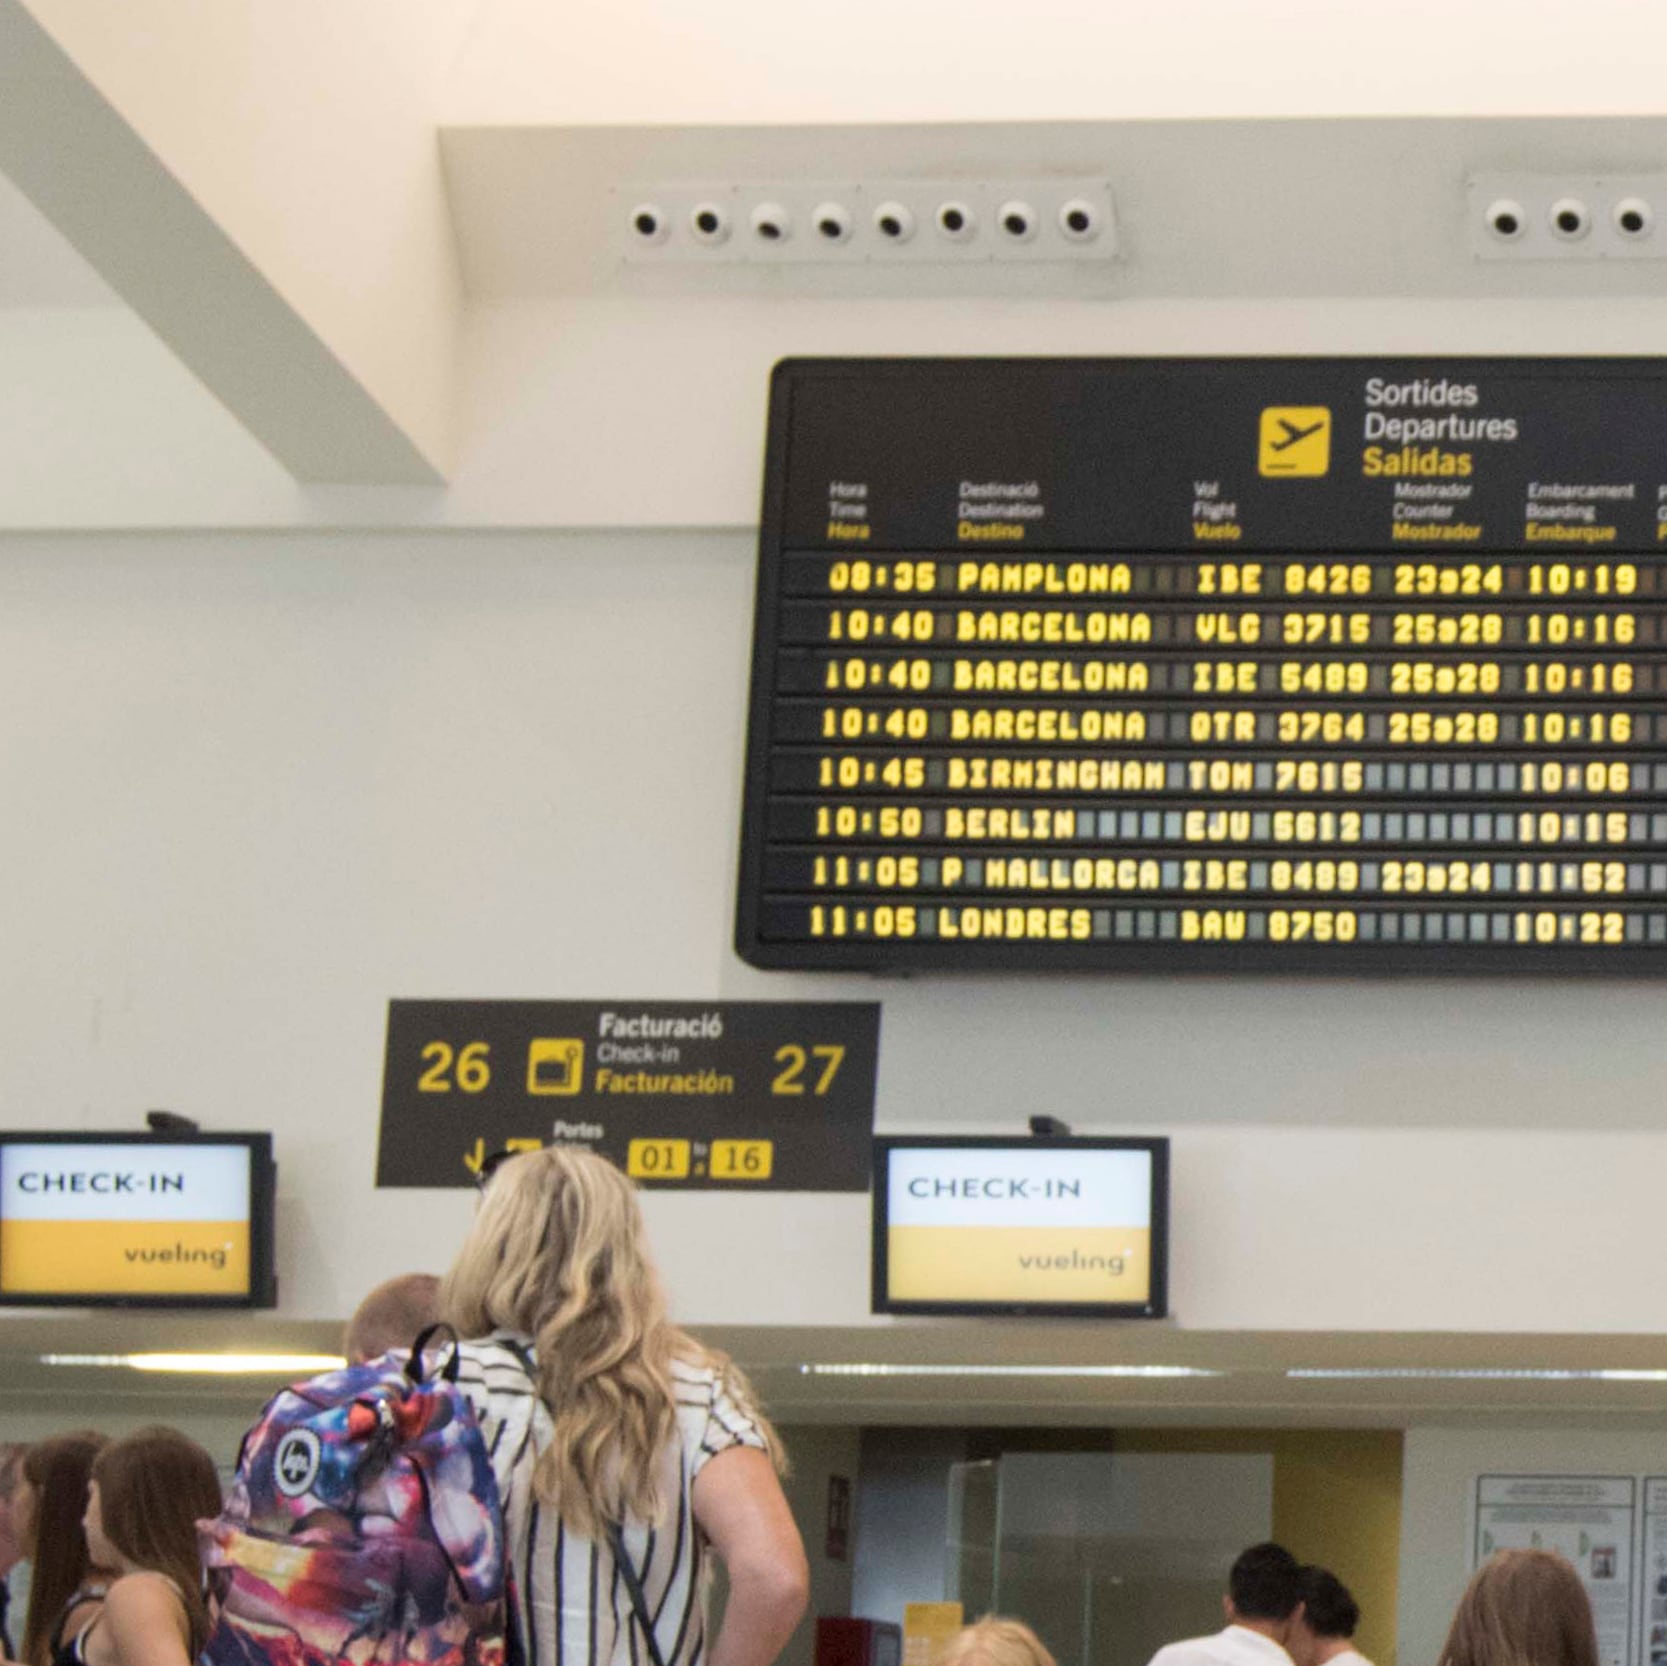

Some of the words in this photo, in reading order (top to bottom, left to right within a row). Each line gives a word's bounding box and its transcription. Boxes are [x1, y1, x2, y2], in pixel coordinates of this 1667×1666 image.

[1365, 377, 1478, 407] Sortides
[1364, 412, 1518, 446] Departures
[1363, 446, 1473, 476] Salidas
[830, 562, 935, 591] 08:35
[959, 563, 1130, 593] PAMPLONA
[1198, 564, 1261, 593] IBE
[1285, 565, 1371, 594] 8426
[1530, 565, 1636, 594] 10:19
[830, 610, 933, 640] 10:40
[957, 611, 1150, 642] BARCELONA
[1196, 614, 1260, 643] VLG
[1284, 614, 1370, 643] 3715
[1529, 614, 1634, 643] 10:16
[824, 708, 927, 738] 10:40
[952, 710, 1145, 740] BARCELONA
[1280, 712, 1364, 742] 3764
[1525, 713, 1630, 742] 10:16
[821, 757, 924, 787] 10:45
[949, 759, 1164, 790] BIRMINGHAM
[1278, 762, 1362, 791] 7615
[1524, 763, 1629, 792] 10:06
[818, 807, 921, 837] 10:50
[946, 808, 1074, 838] BERLIN
[815, 857, 918, 886] 11:05
[942, 858, 962, 886] P
[986, 859, 1159, 889] MALLORCA
[1186, 861, 1247, 890] IBE
[1515, 862, 1625, 892] 11:52
[812, 907, 915, 936] 11:05
[939, 908, 1090, 939] LONDRES
[1183, 911, 1245, 940] BAW
[1270, 911, 1356, 941] 8750
[1519, 912, 1623, 942] 10:22
[599, 1012, 723, 1039] Facturació
[418, 1041, 490, 1094] 26
[596, 1042, 680, 1065] Check-in
[595, 1068, 734, 1095] Facturación
[771, 1044, 846, 1096] 27
[641, 1145, 675, 1171] 01
[726, 1146, 761, 1172] 16
[18, 1172, 184, 1194] CHECK-IN
[907, 1177, 1081, 1200] CHECK-IN
[124, 1242, 227, 1270] vueling
[1019, 1250, 1127, 1277] vueling
